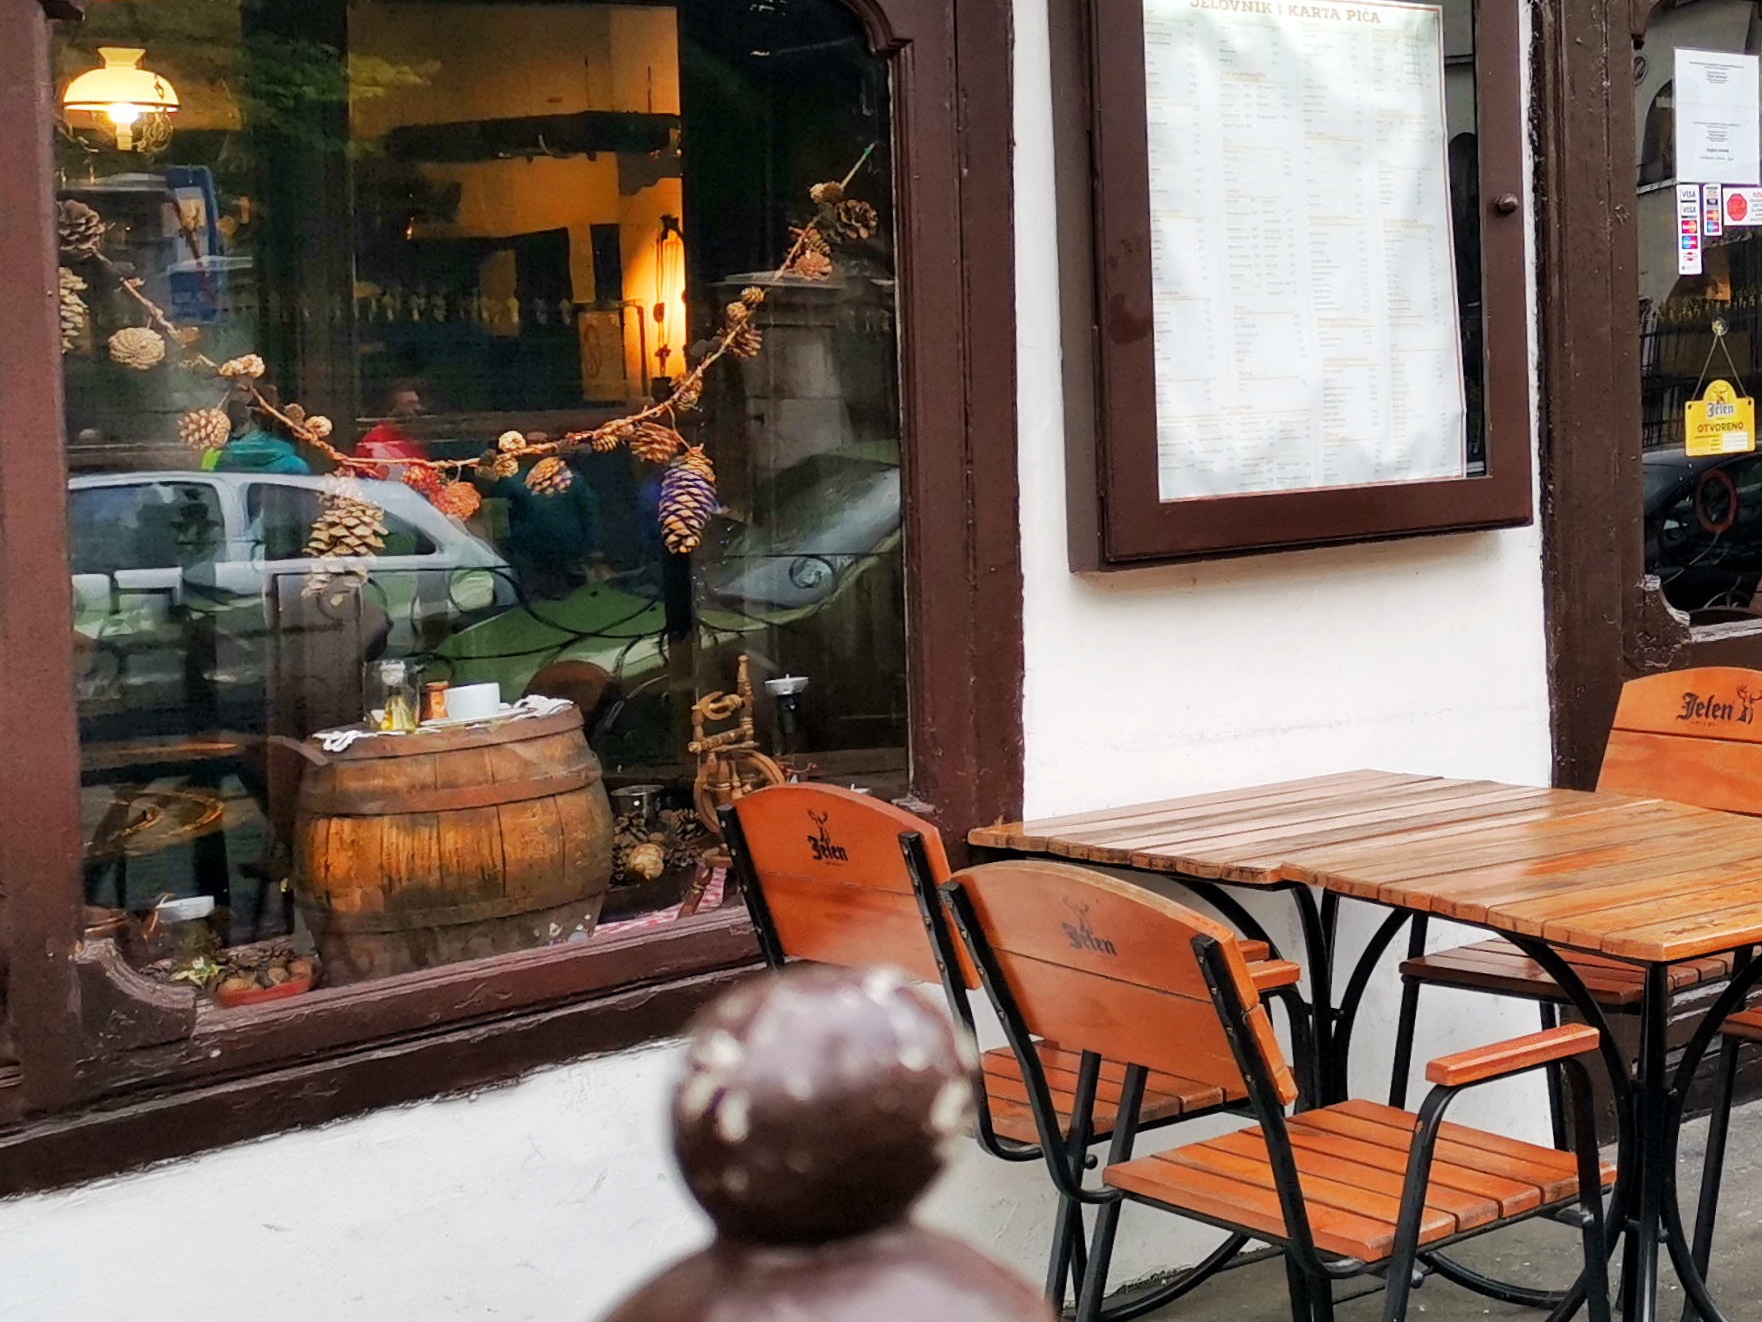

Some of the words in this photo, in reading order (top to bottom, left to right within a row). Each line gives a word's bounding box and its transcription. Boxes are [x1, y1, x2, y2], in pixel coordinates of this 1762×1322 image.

[1277, 3, 1284, 15] I
[1288, 4, 1341, 21] KARTA
[1682, 206, 1697, 214] VISA
[1707, 402, 1734, 418] Jelen
[1697, 421, 1744, 433] OTVORENO
[1675, 691, 1734, 721] Jelen
[1061, 922, 1118, 957] Jelen
